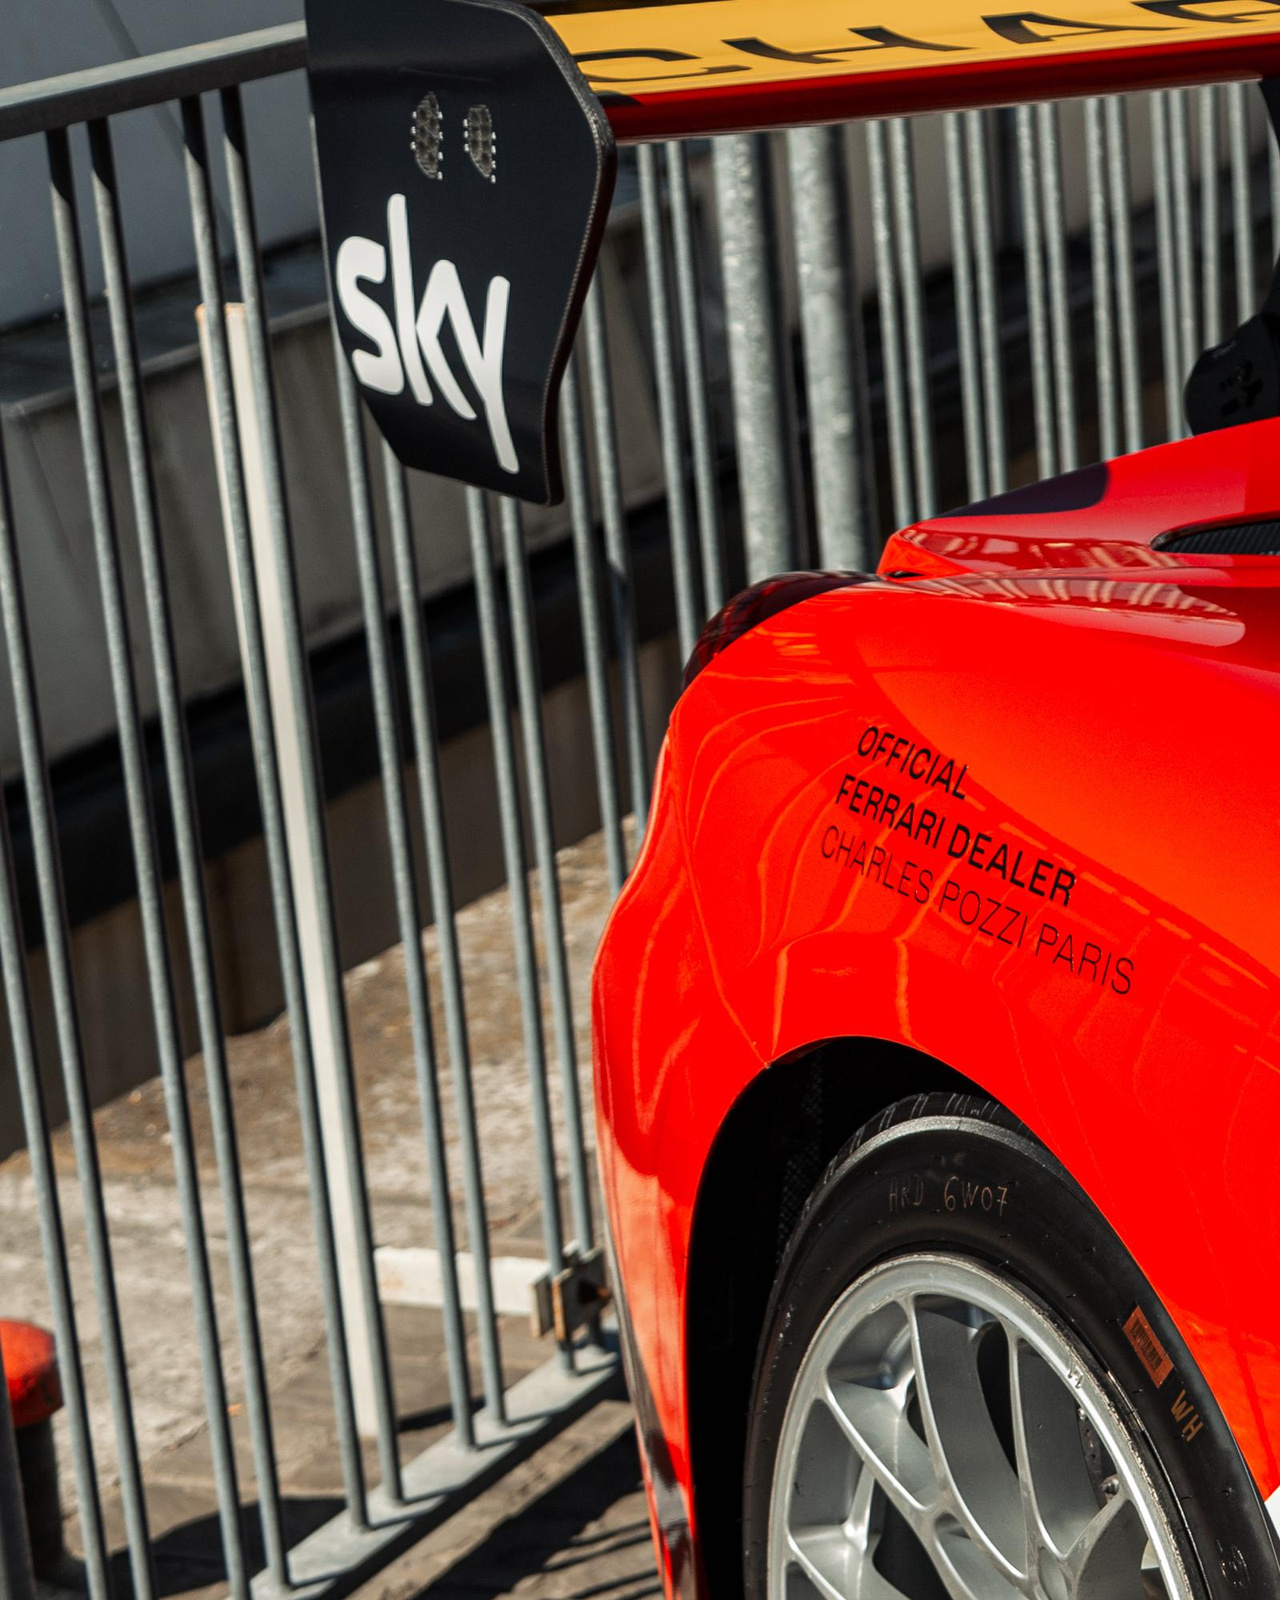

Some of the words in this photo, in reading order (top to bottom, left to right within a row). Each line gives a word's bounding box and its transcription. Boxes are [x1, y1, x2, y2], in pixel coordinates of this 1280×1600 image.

[336, 193, 519, 475] sky
[857, 726, 970, 801] OFFICIAL
[820, 825, 934, 905] CHARLES
[938, 880, 1029, 948] POZZI
[1035, 923, 1135, 995] PARIS
[835, 774, 946, 849] FERRARI
[946, 824, 1077, 907] DEALER
